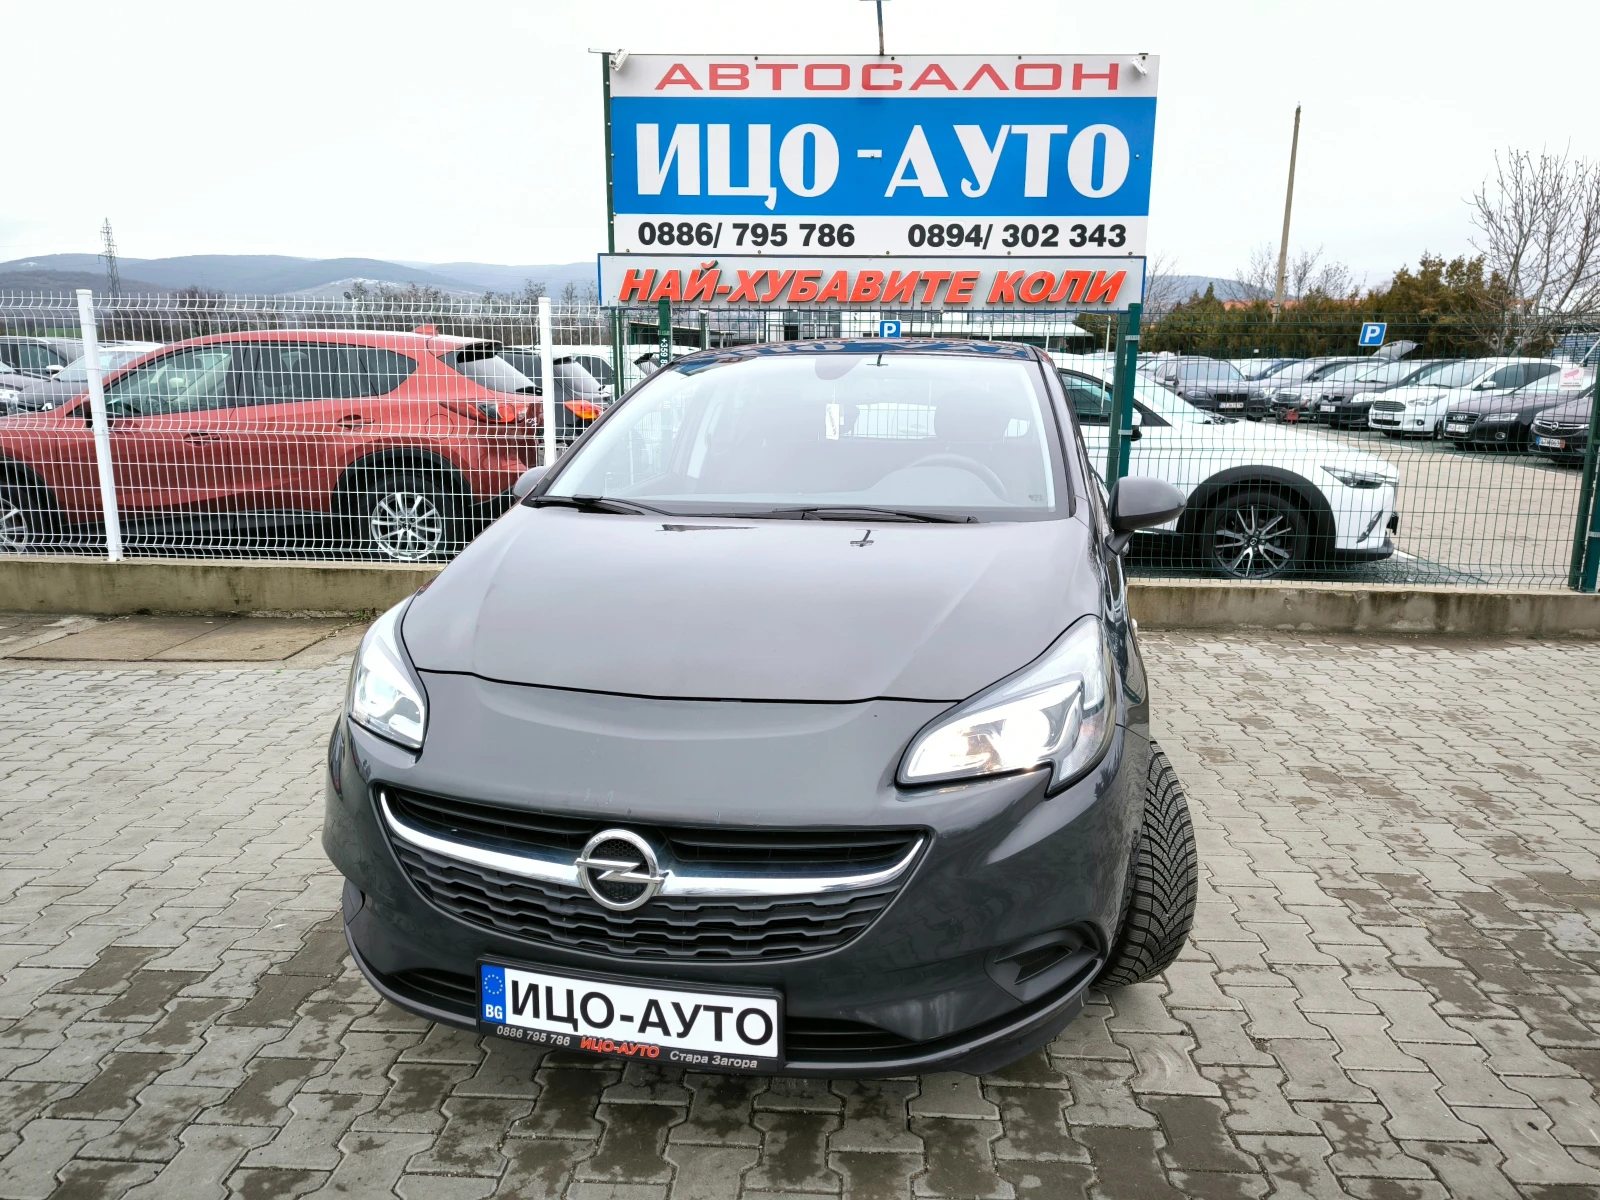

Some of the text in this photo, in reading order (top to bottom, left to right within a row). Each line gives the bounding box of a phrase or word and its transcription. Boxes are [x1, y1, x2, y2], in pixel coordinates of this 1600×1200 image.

[655, 63, 1119, 91] АВТОСАЛОН
[636, 123, 840, 210] ИЦО
[638, 221, 855, 249] 0886/ 795 786
[907, 223, 1126, 249] 0894/ 302 343
[617, 260, 1128, 304] НАЙ-ХУБАВИТЕ КОЛИ
[884, 323, 897, 337] P
[1364, 325, 1381, 343] P
[660, 337, 669, 357] +359
[485, 1003, 503, 1020] BG
[511, 979, 774, 1046] ИЦО-АУТО
[496, 1025, 571, 1046] 0886 795 786
[580, 1036, 660, 1058] ИЦО-АУТО
[669, 1050, 758, 1069] Стара Загора
